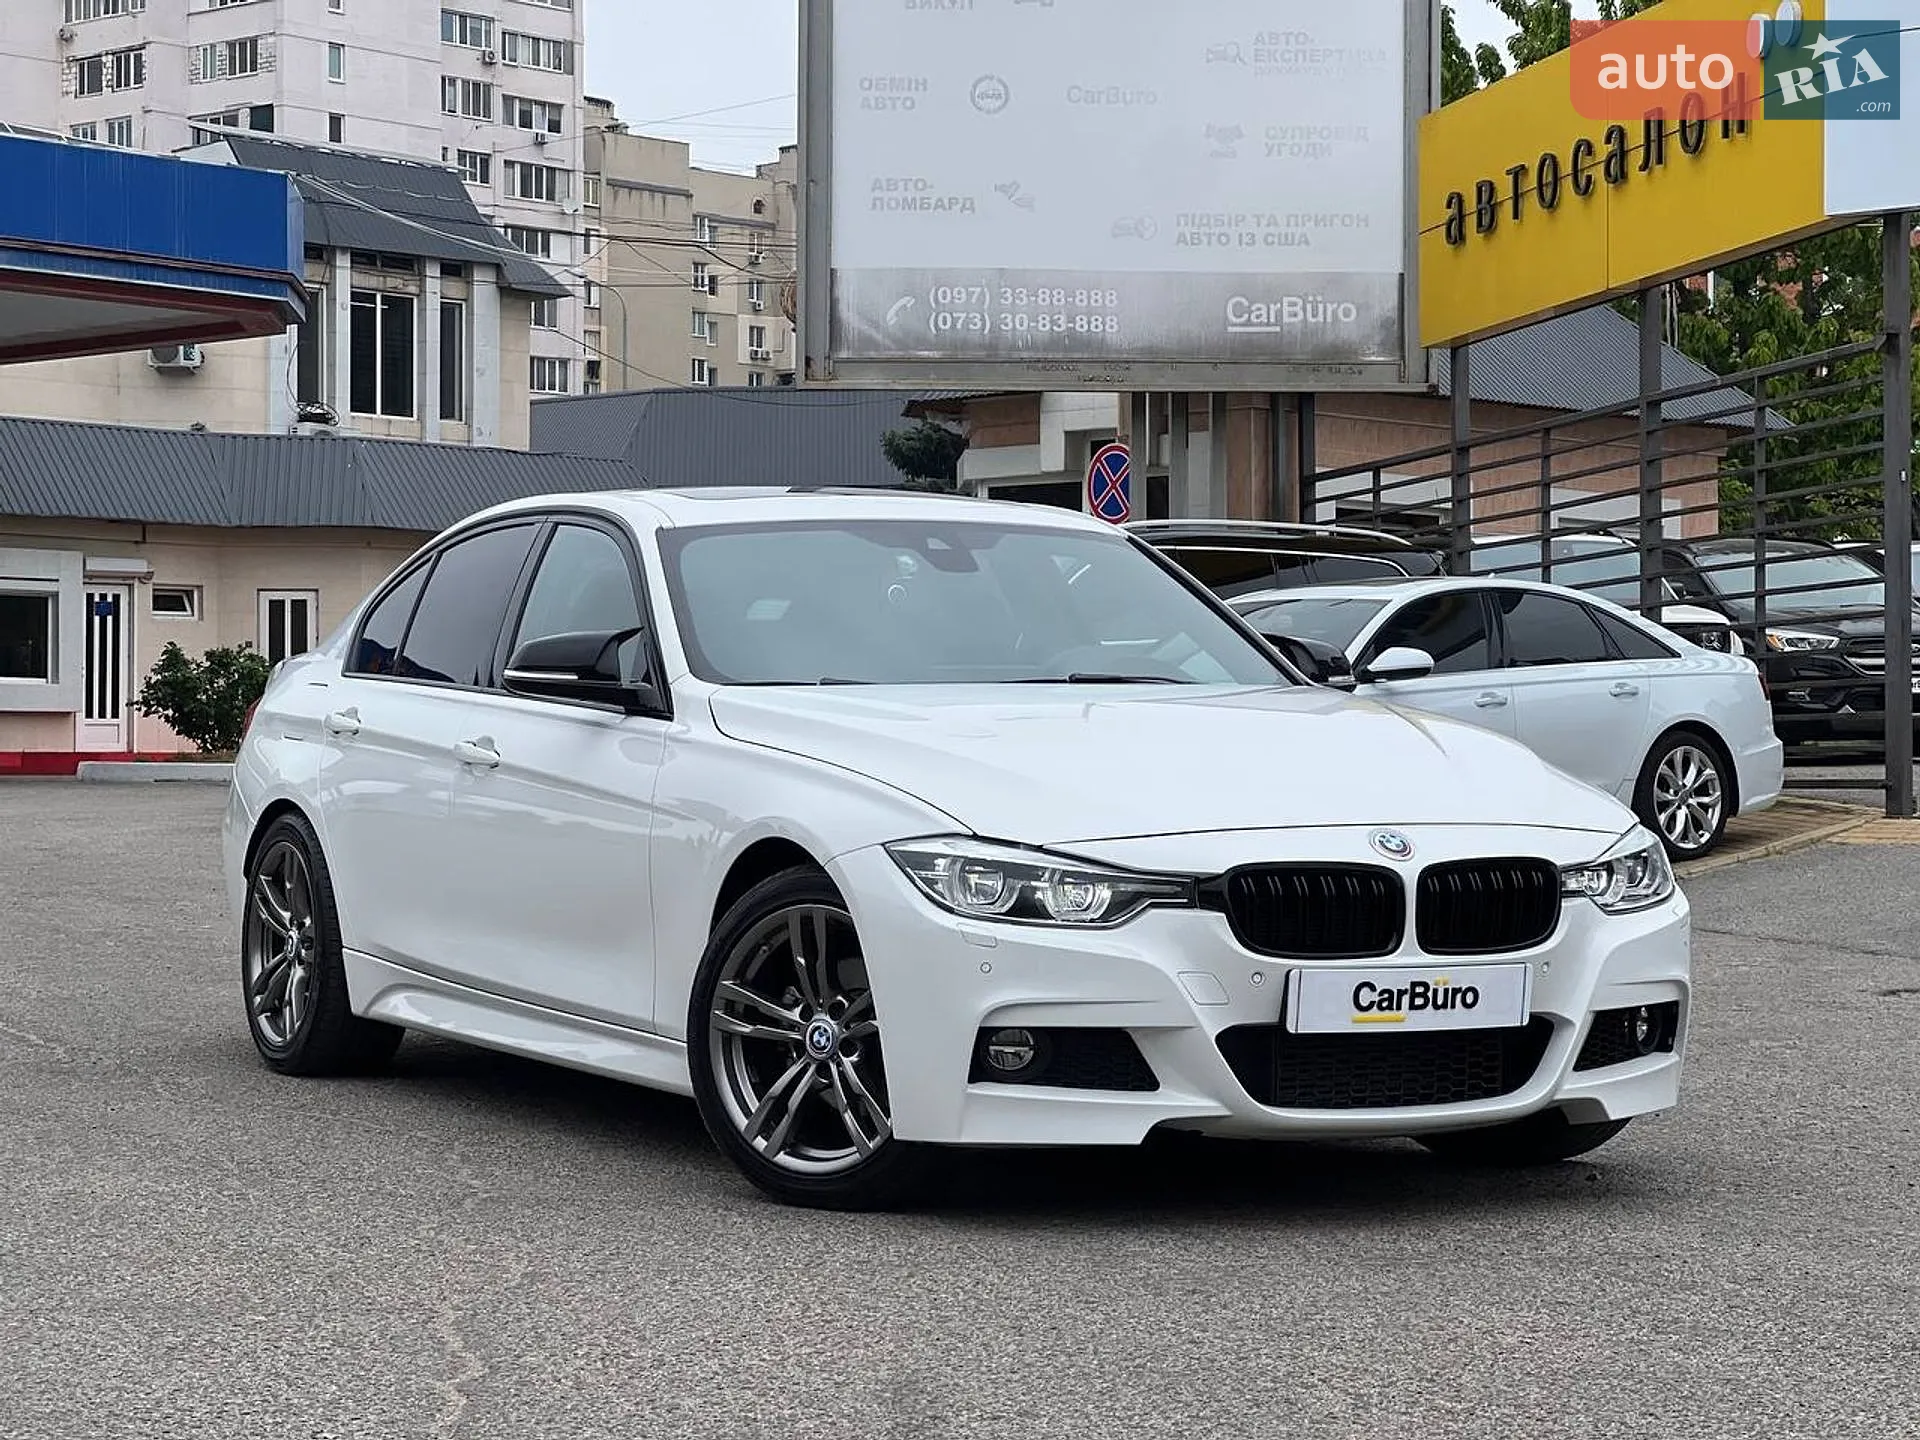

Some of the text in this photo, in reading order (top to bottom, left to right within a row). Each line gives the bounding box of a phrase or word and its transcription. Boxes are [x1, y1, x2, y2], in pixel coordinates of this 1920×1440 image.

[1252, 31, 1315, 46] АВТО-
[858, 76, 929, 92] ОБМІН
[859, 96, 917, 111] АВТО
[1264, 142, 1333, 159] УГОДИ
[871, 177, 935, 193] АВТО-
[870, 196, 976, 214] ЛОМБАРД
[1175, 213, 1370, 229] ПІДБІР ТА ПРИГОН
[1175, 232, 1231, 248] АВТО
[1262, 232, 1311, 248] США
[929, 286, 1118, 309] (097) 33-88-888
[1226, 295, 1357, 323] CarBüro
[929, 311, 1119, 335] (073) 30-83-888
[1352, 977, 1480, 1013] CarBüro
